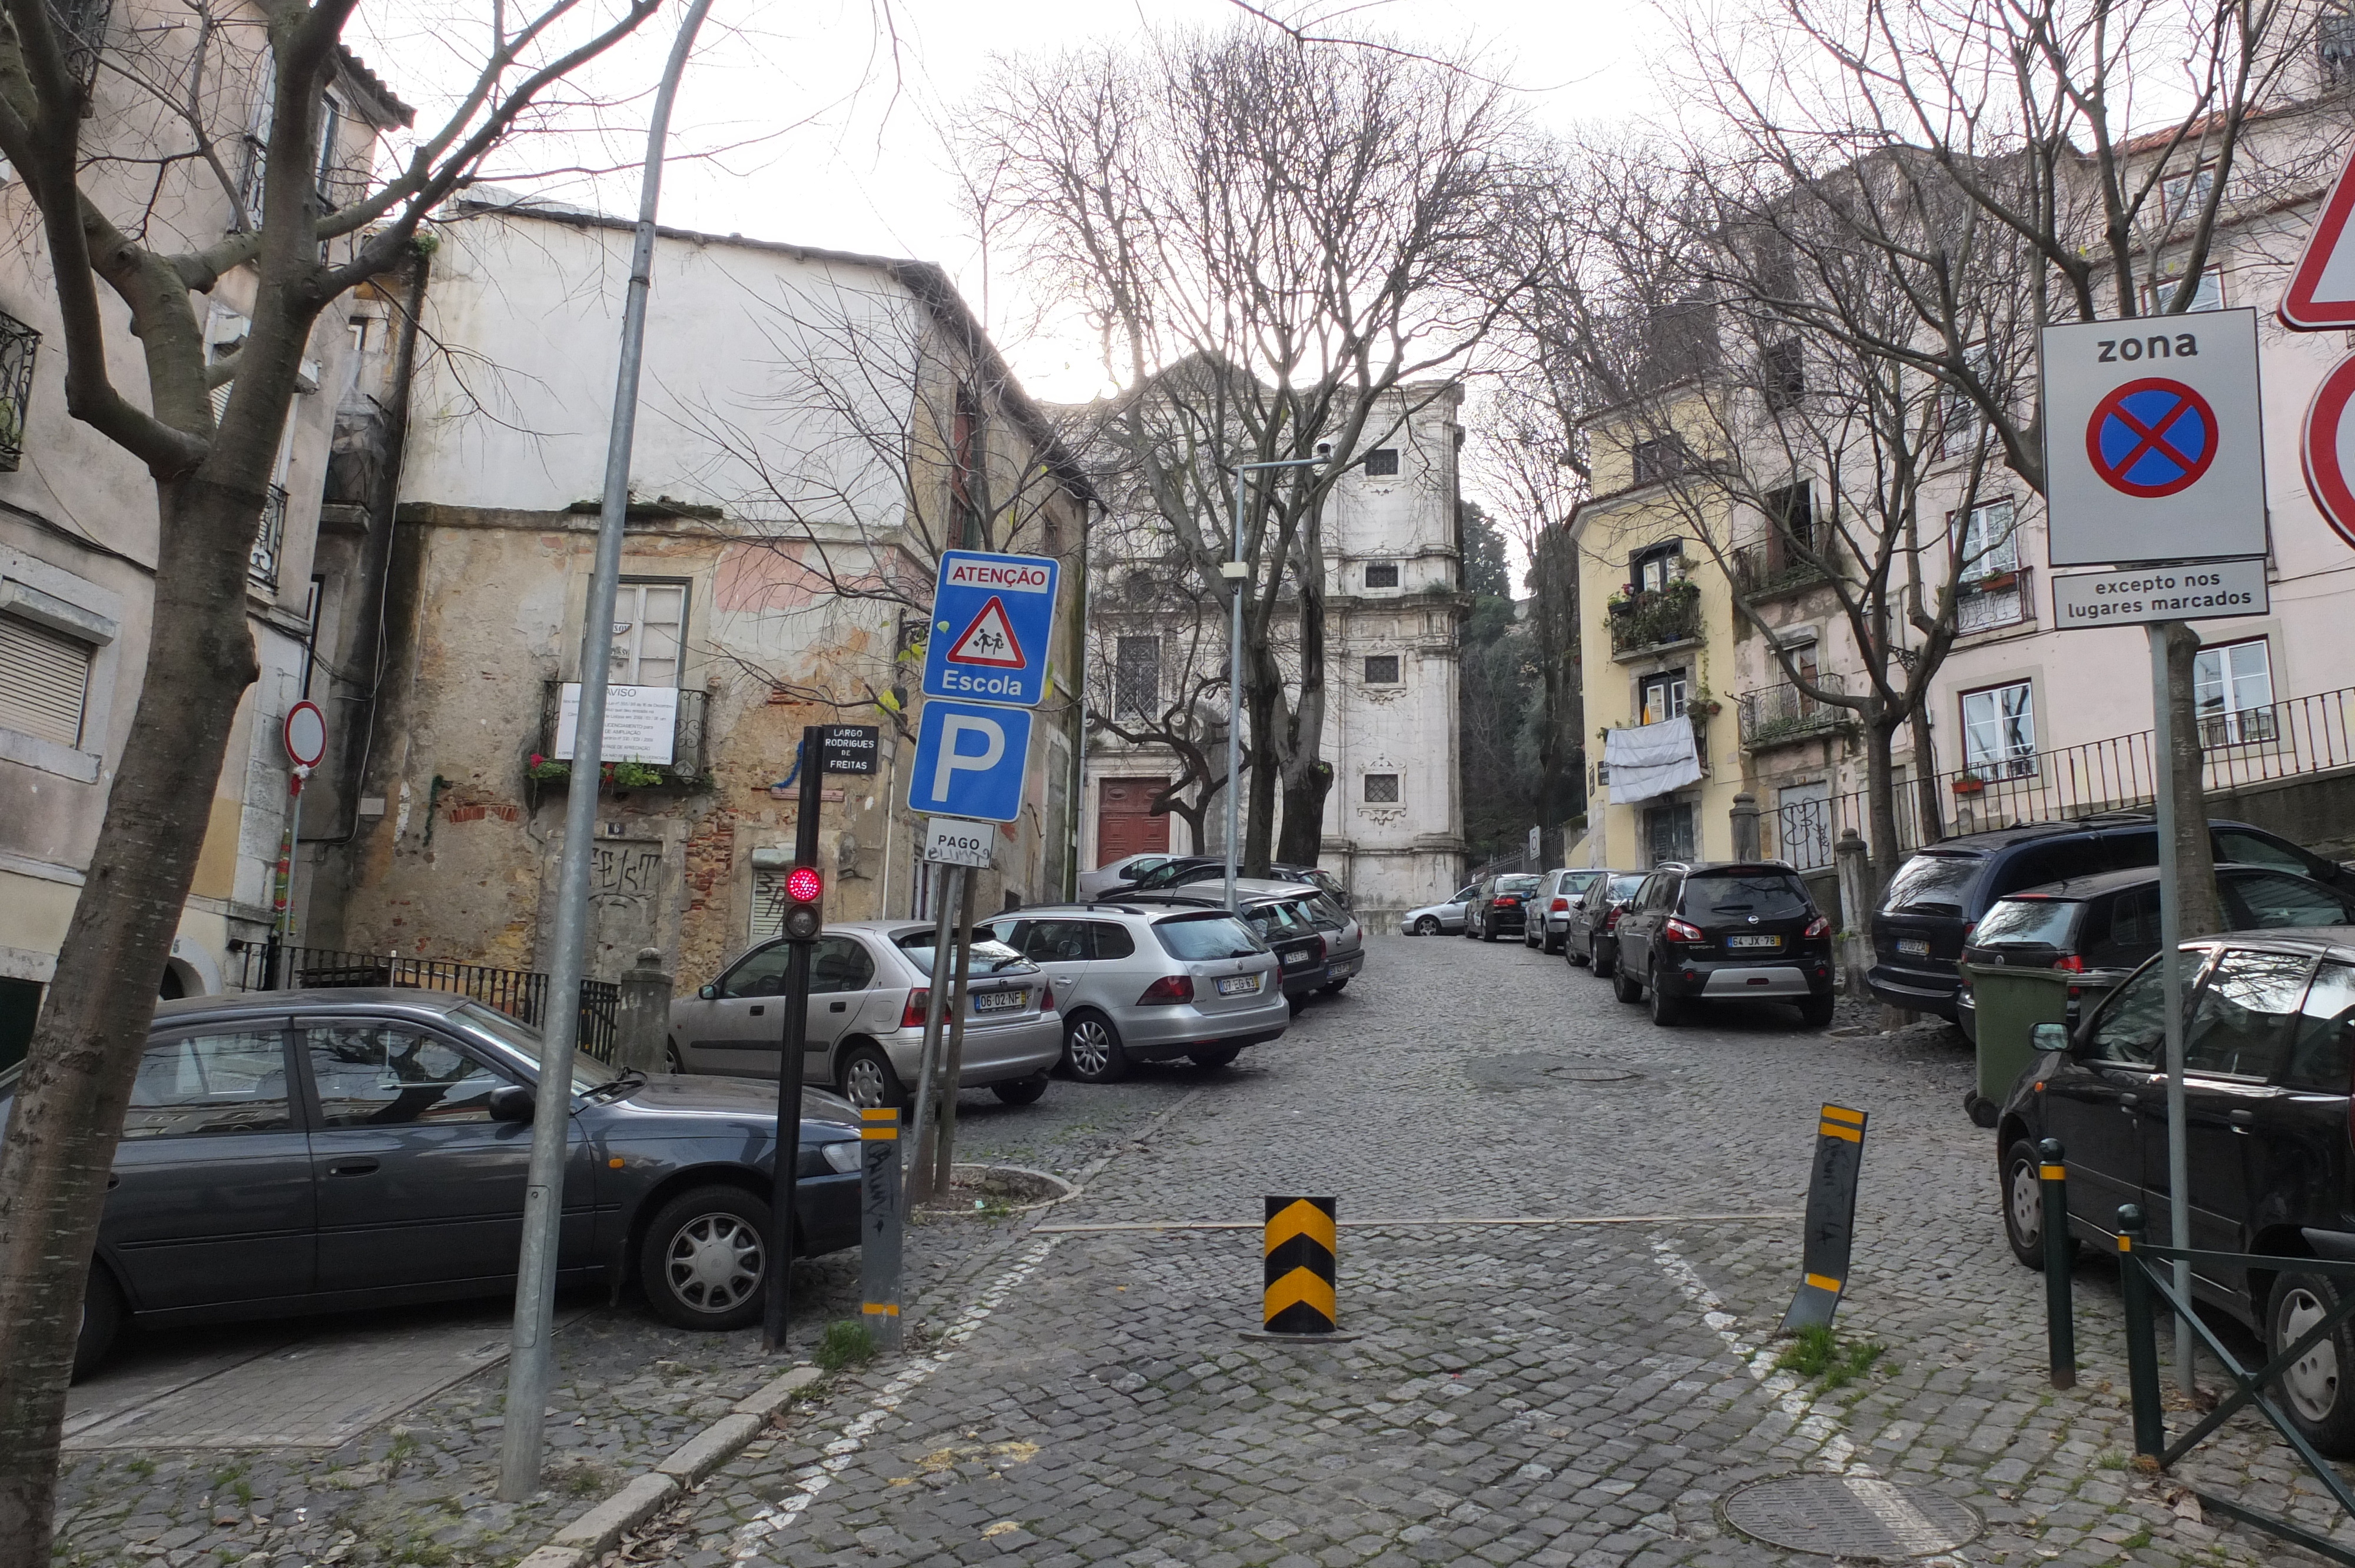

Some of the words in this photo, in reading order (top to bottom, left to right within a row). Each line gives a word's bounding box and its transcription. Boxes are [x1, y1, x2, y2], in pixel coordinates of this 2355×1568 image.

[2097, 332, 2198, 363] zona
[952, 566, 1046, 587] ATENÇÃO
[2095, 574, 2176, 595] excepto
[2184, 573, 2220, 587] nos
[2068, 598, 2143, 619] lugares
[2151, 590, 2252, 611] marcados
[942, 669, 1022, 696] Escola
[825, 739, 874, 748] RODRIGUES
[834, 729, 863, 737] LARGO
[830, 760, 867, 770] FREITAS
[931, 713, 1006, 802] P
[613, 823, 619, 833] 6
[938, 834, 980, 850] PAGO
